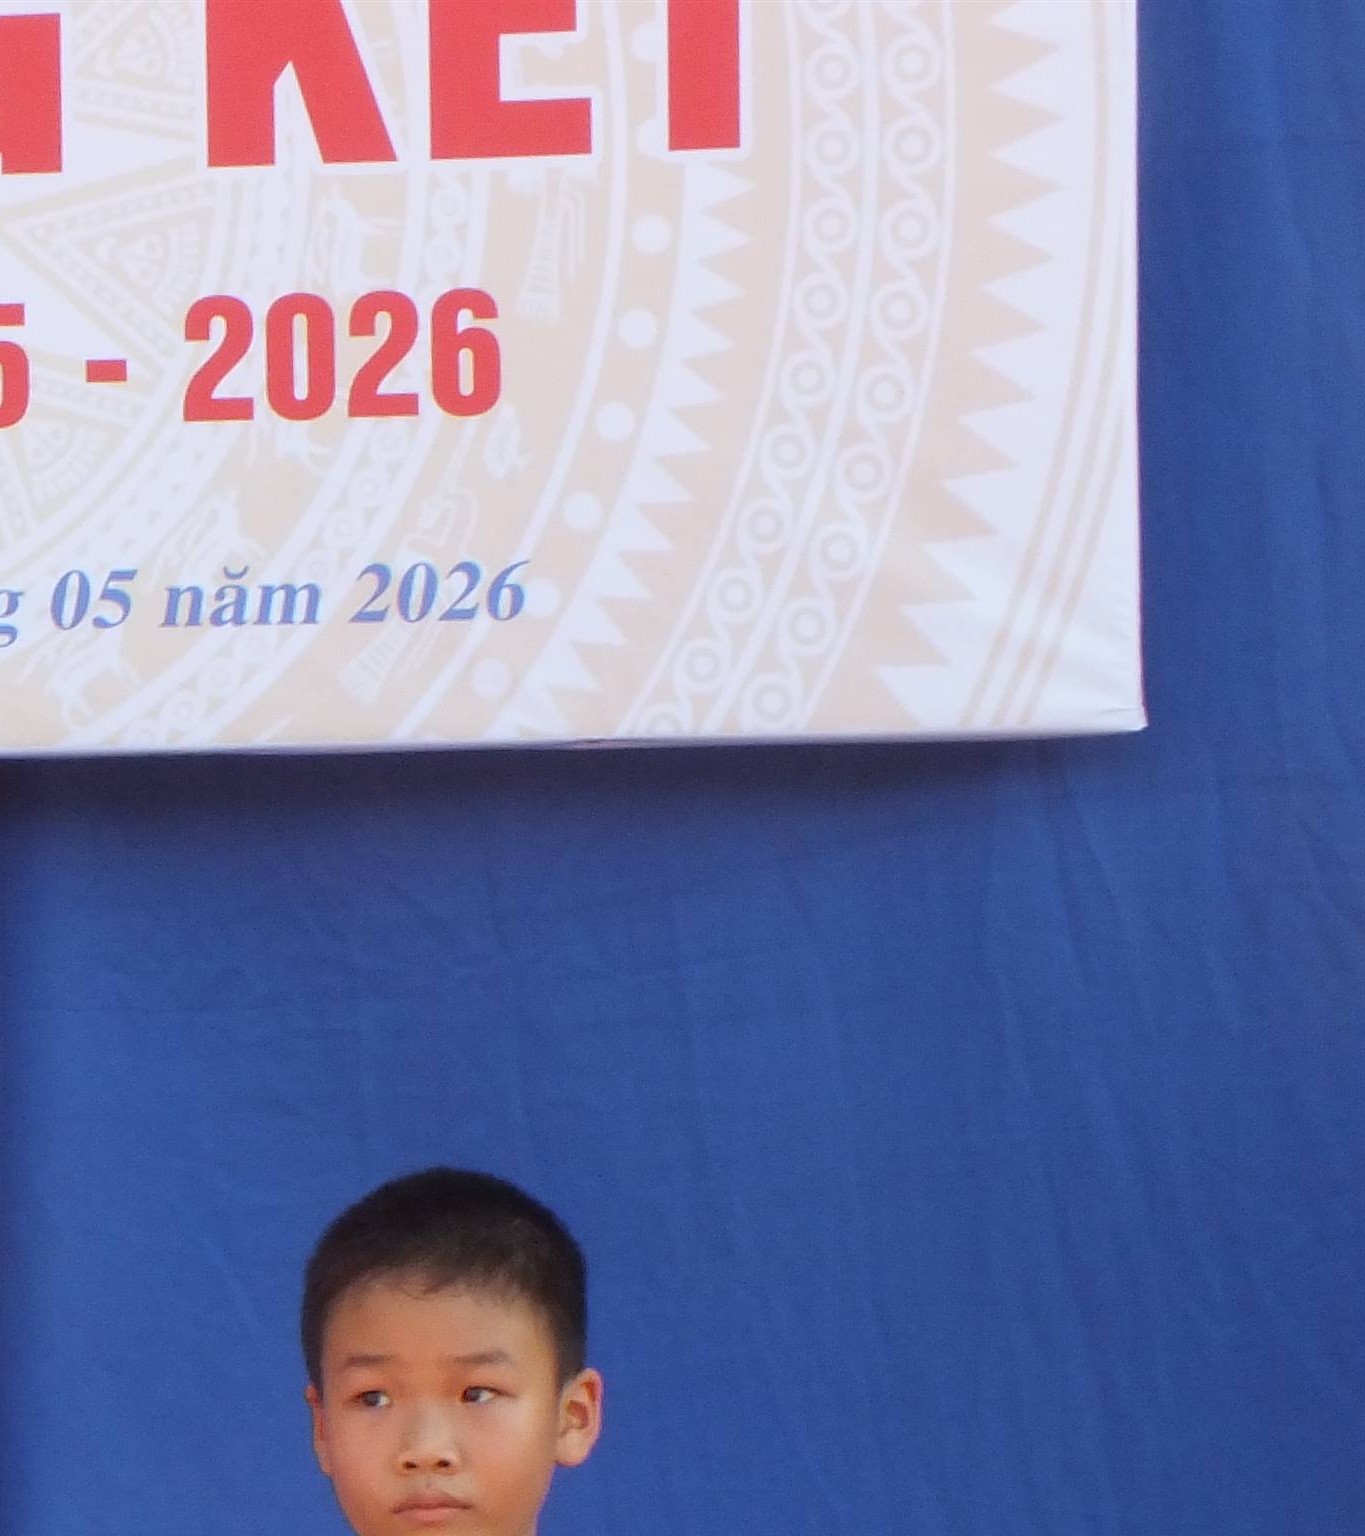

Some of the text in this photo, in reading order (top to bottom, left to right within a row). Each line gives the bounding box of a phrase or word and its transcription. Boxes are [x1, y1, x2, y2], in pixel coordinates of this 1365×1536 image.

[85, 359, 128, 383] -
[183, 287, 503, 422] 2026
[49, 568, 139, 631] 05
[158, 564, 324, 629] năm
[347, 560, 533, 624] 2026
